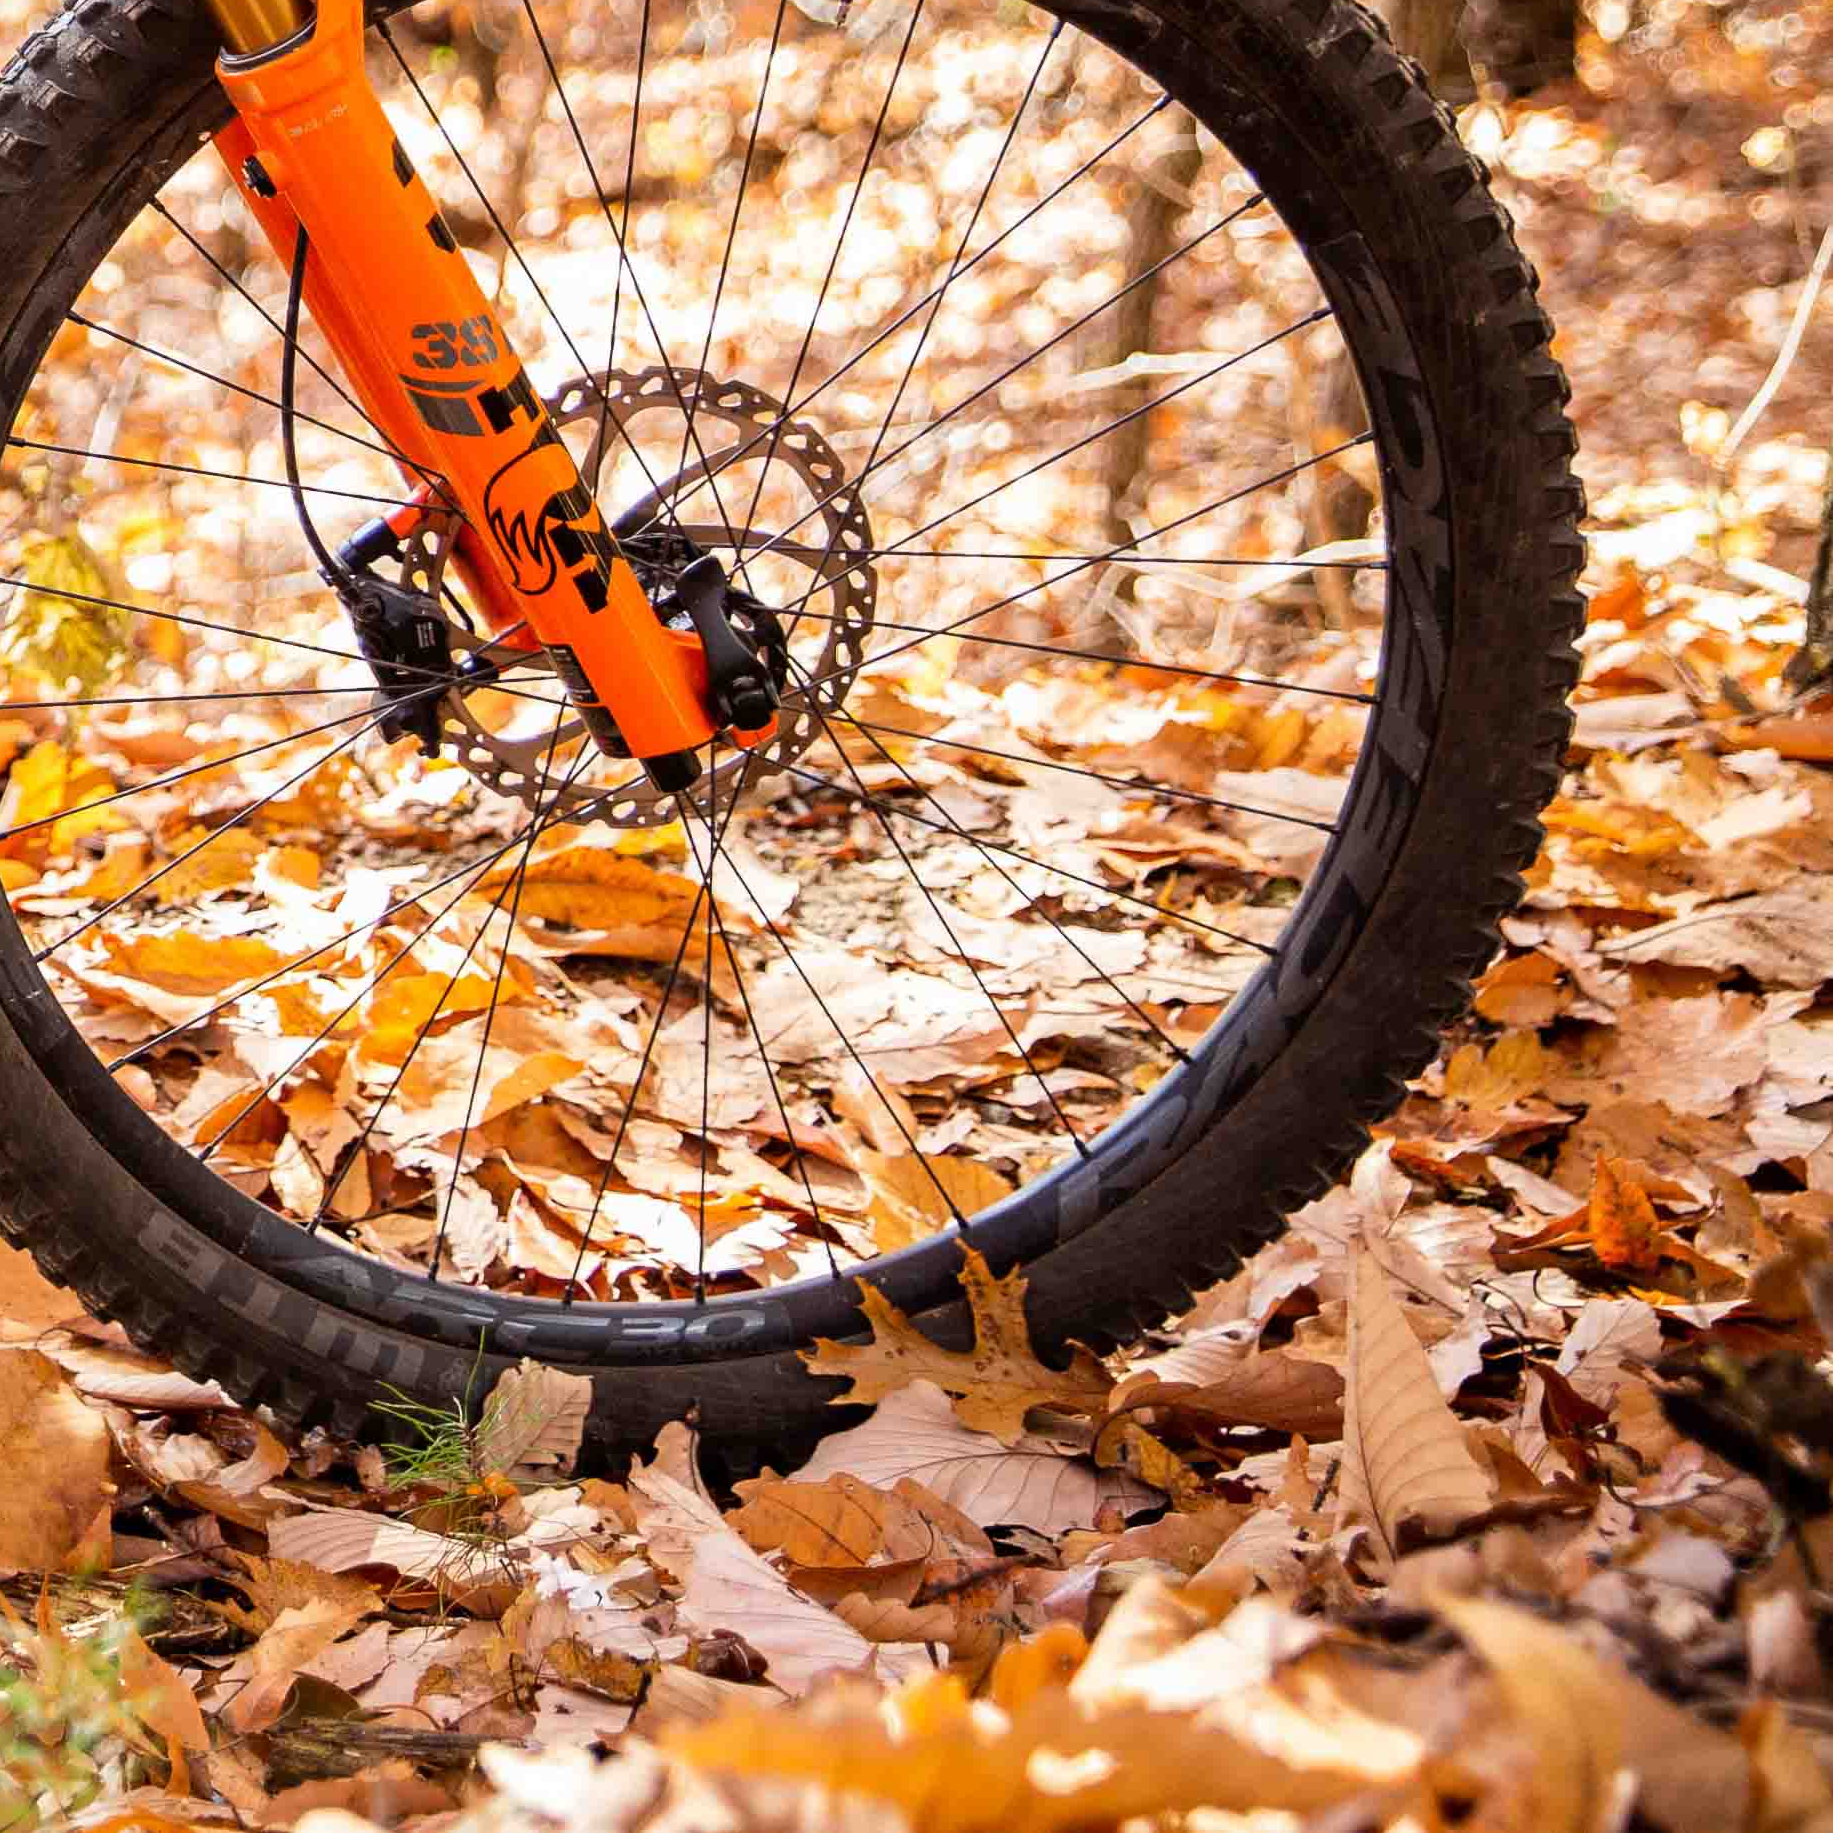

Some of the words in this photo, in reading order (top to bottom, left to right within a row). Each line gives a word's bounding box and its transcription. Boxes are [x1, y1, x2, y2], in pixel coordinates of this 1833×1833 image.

[411, 314, 499, 370] 38
[136, 1208, 426, 1390] WTB
[618, 1307, 768, 1345] 30
